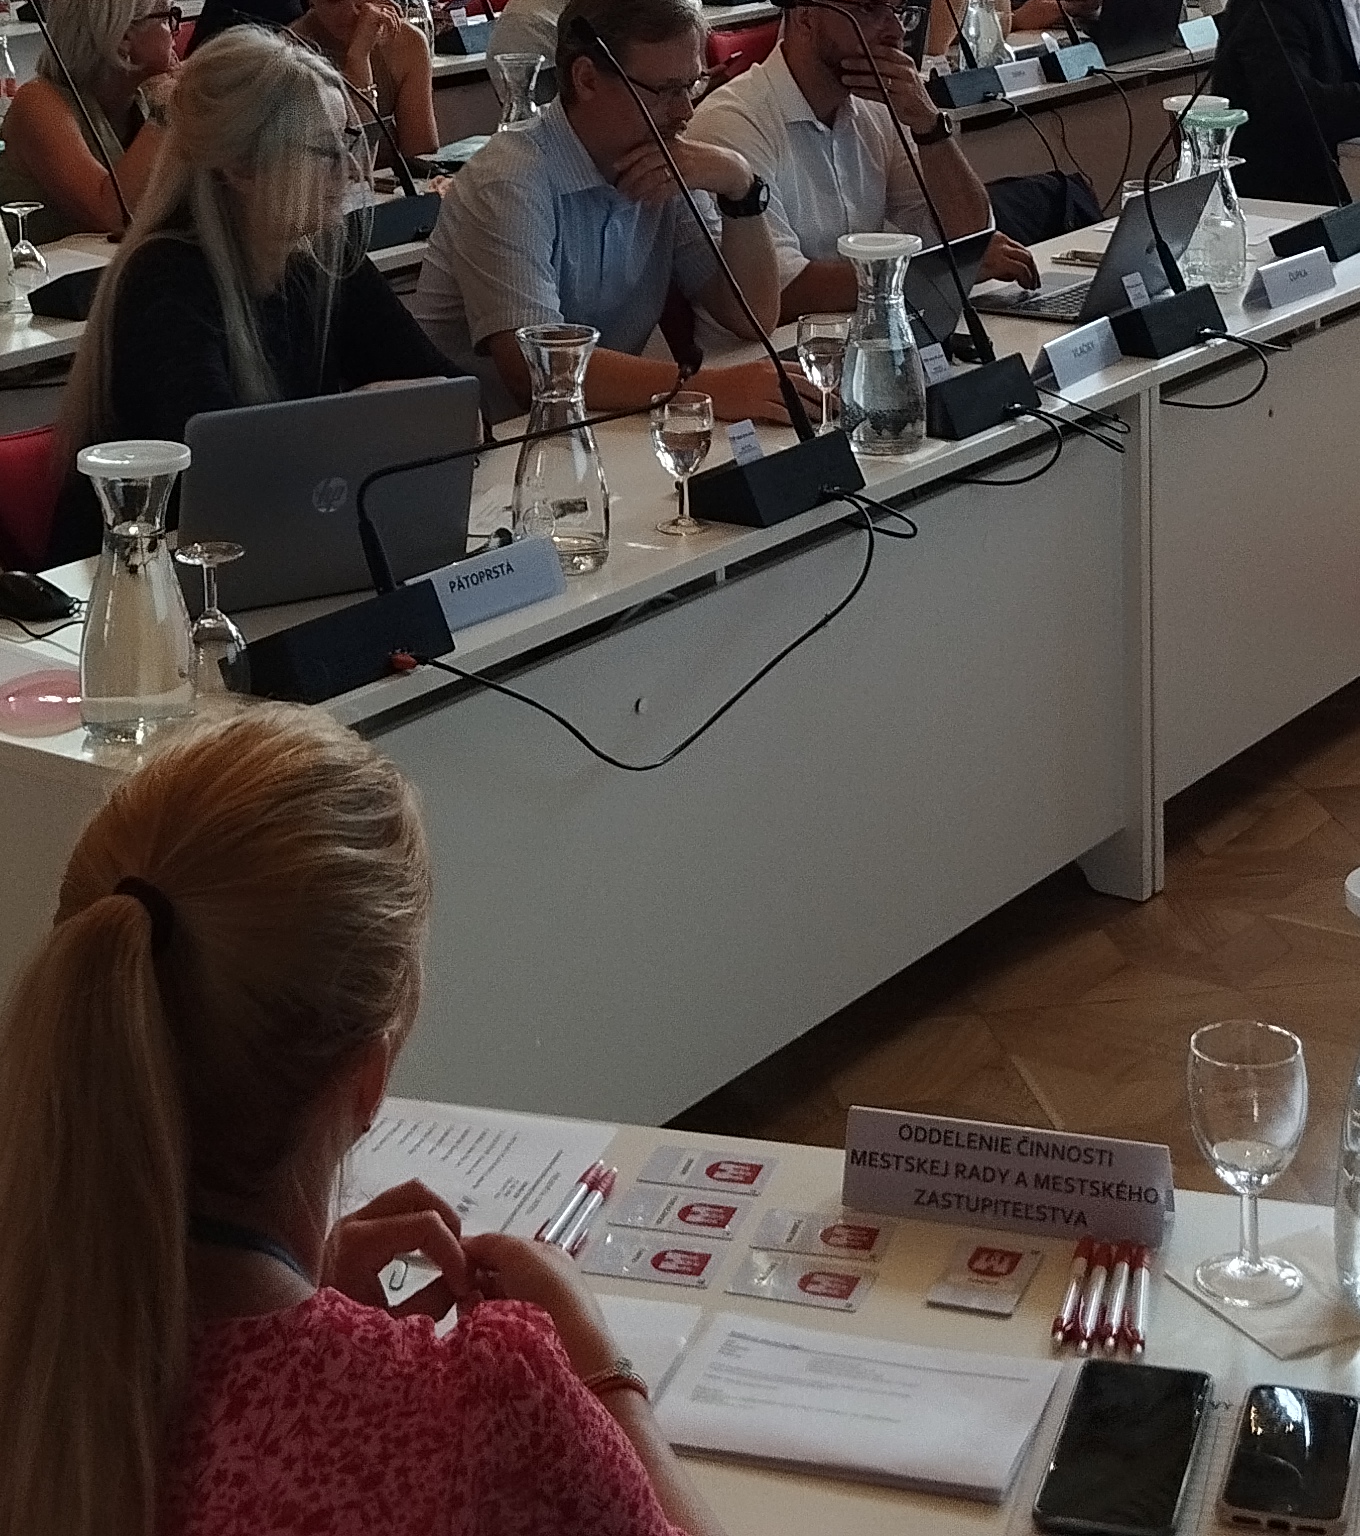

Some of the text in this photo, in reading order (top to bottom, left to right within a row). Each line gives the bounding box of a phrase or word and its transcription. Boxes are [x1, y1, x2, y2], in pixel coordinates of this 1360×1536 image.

[898, 1123, 1114, 1167] ODDELENIE ČINNOSTI
[850, 1148, 1160, 1205] MESTSKEJ RADY A MESTSKÉHO
[913, 1188, 1089, 1227] ZASTUPITEĽSTVA
